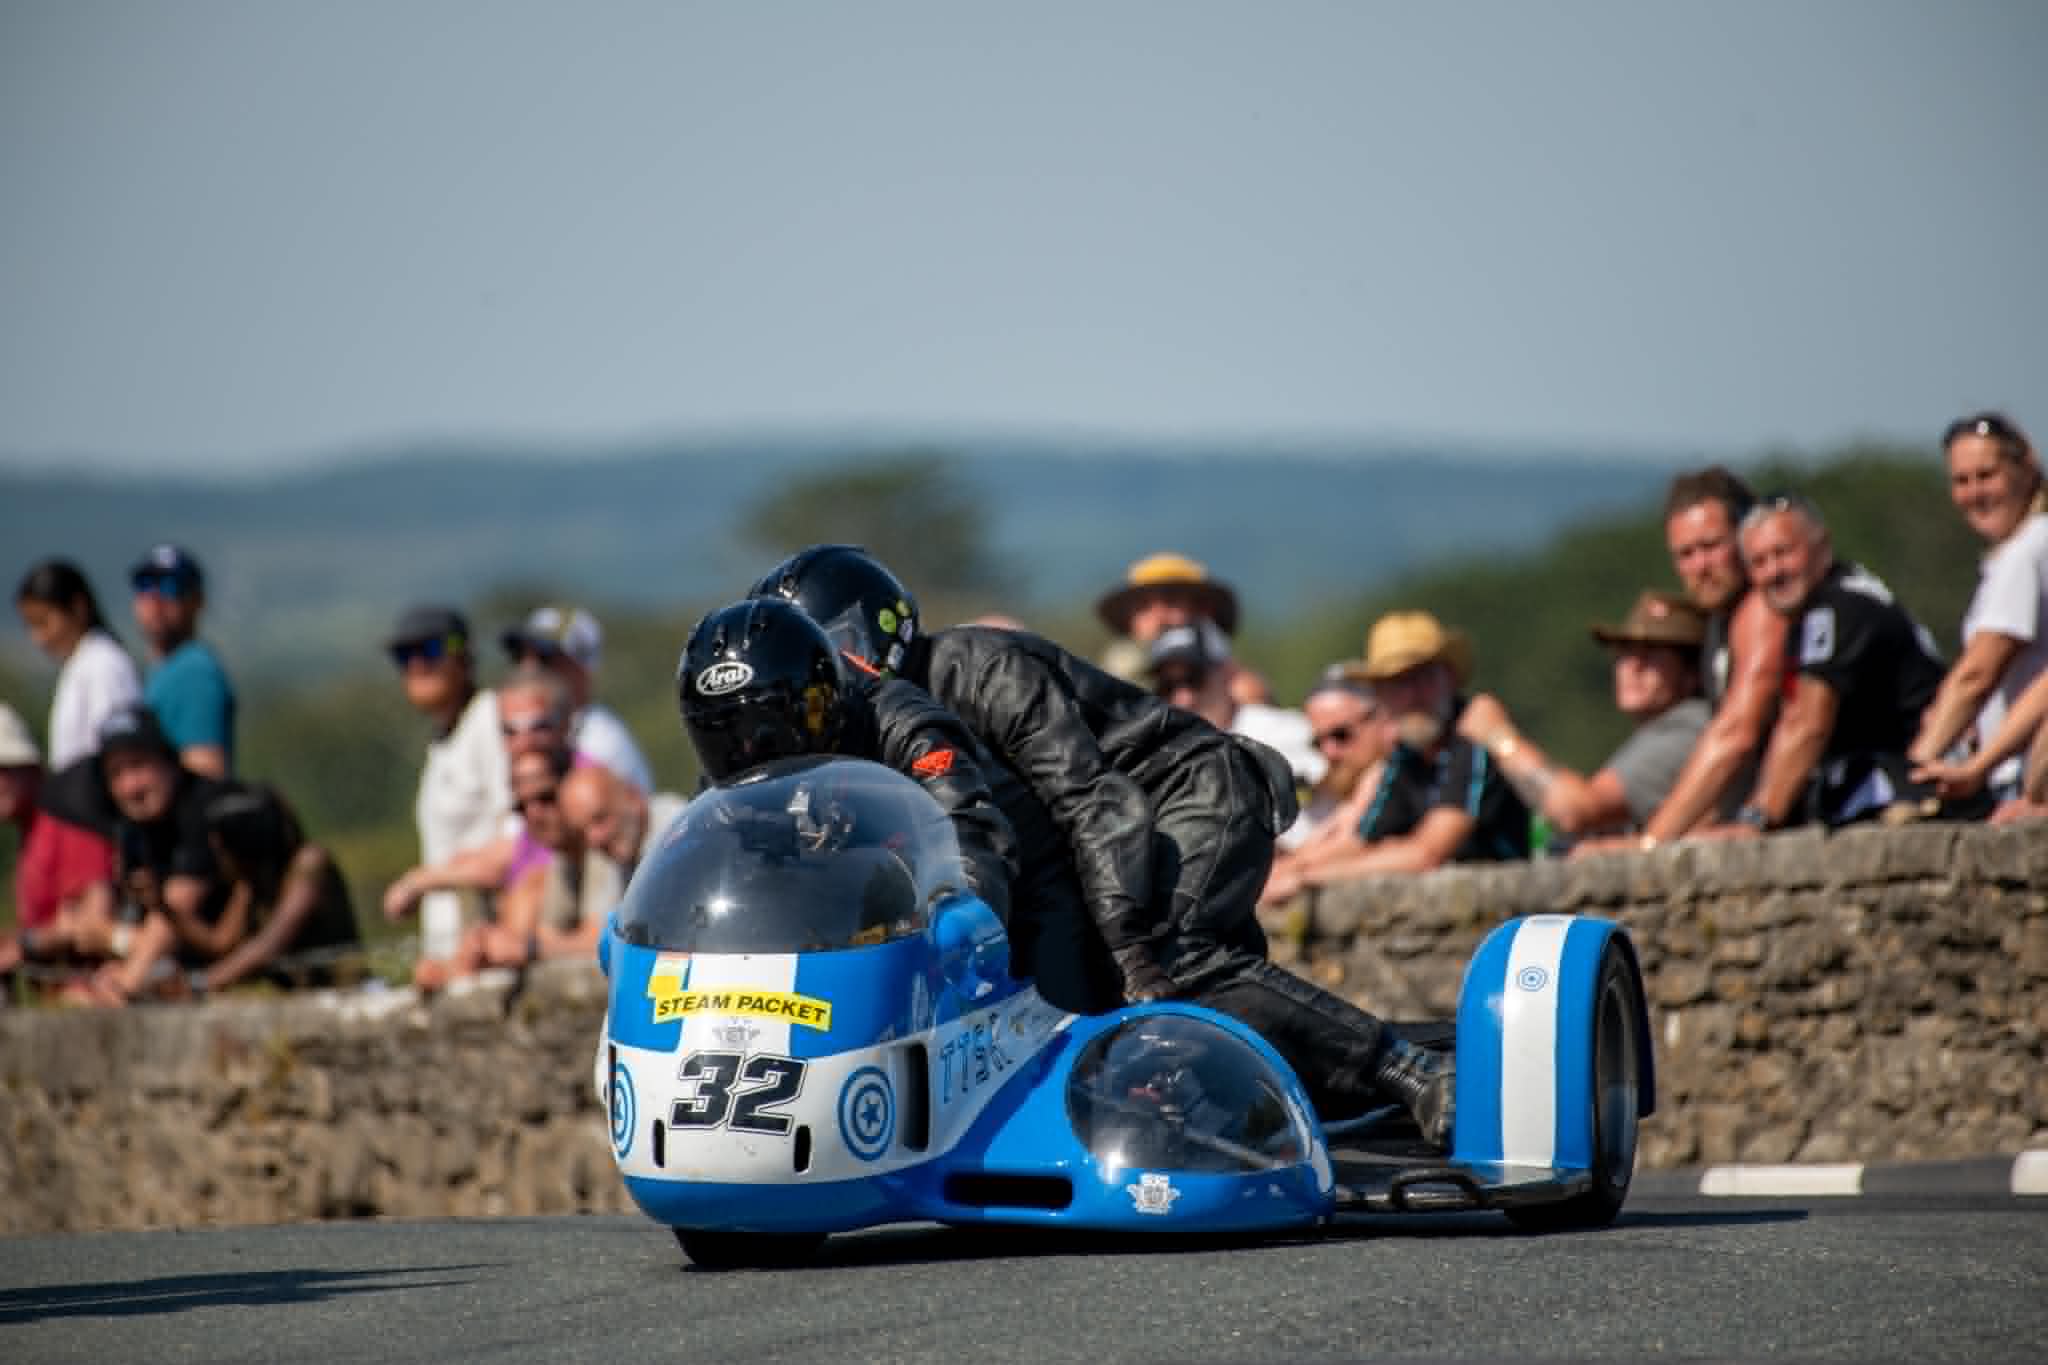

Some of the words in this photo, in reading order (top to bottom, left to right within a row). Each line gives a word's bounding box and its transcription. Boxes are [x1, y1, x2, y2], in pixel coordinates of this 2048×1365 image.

[657, 995, 730, 1016] STEAM
[736, 995, 828, 1023] PACKET
[669, 1051, 807, 1136] 32
